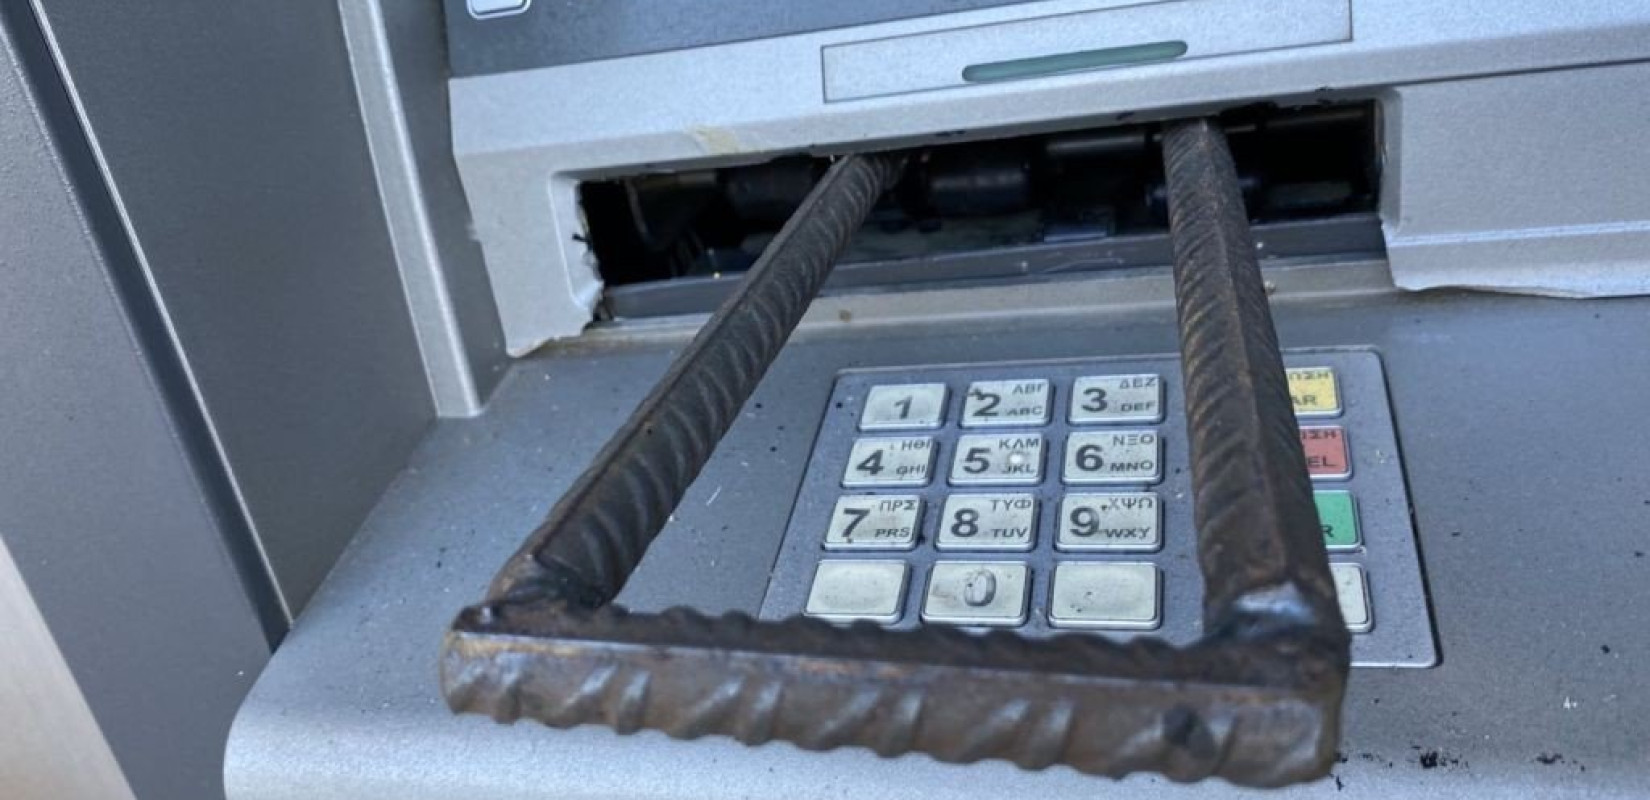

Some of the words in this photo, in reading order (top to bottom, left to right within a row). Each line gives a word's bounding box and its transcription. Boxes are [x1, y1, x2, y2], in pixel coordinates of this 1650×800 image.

[894, 396, 912, 419] 1
[974, 392, 1000, 416] 2
[1006, 405, 1044, 416] ABC
[1082, 388, 1107, 412] 3
[1121, 402, 1155, 412] DEF
[856, 450, 884, 475] 4
[896, 464, 927, 475] GHI
[964, 448, 992, 474] 5
[1002, 464, 1035, 474] JKL
[1076, 444, 1103, 472] 6
[1110, 461, 1154, 472] MNO
[842, 508, 870, 538] 7
[874, 528, 910, 538] PRS
[951, 508, 979, 538] 8
[991, 528, 1028, 538] TUV
[1070, 507, 1098, 538] 9
[1104, 528, 1151, 538] WXY
[964, 568, 996, 606] 0
